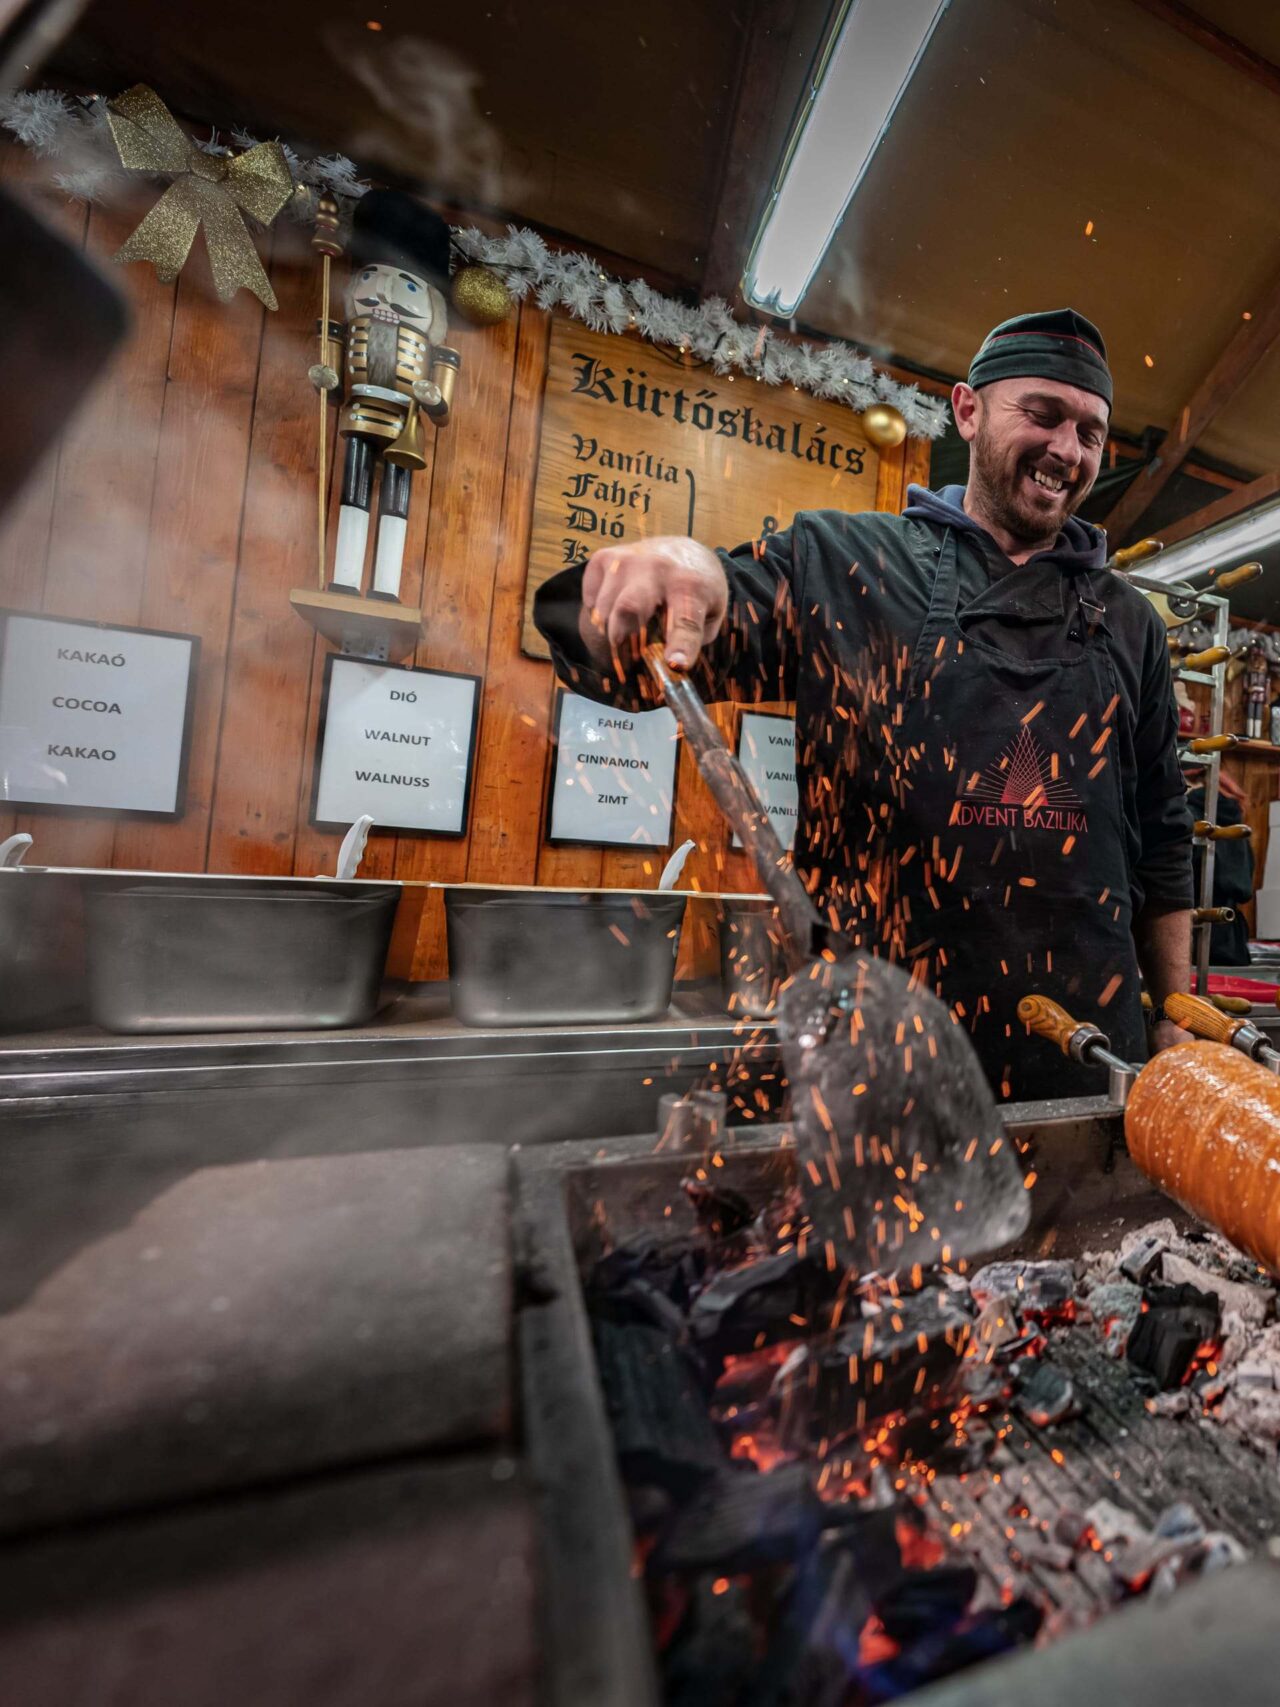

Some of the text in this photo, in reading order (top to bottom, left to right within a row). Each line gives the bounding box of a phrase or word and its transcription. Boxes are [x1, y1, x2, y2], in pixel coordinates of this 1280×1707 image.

[571, 353, 867, 475] Kürtőskalács
[572, 433, 679, 484] Vanília
[562, 472, 652, 514] Fahéj
[564, 502, 625, 538] Dió
[57, 647, 126, 668] KAKAÓ
[389, 690, 418, 703] DIÓ
[52, 696, 122, 715] COCOA
[598, 718, 634, 731] FAHÉJ
[364, 729, 432, 746] WALNUT
[768, 736, 795, 747] VANI
[47, 744, 117, 761] KAKAO
[577, 753, 649, 770] CINNAMON
[354, 770, 431, 788] WALNUSS
[765, 771, 797, 782] VANIL
[597, 794, 629, 805] ZIMT
[763, 806, 799, 817] VANILL
[1023, 809, 1088, 833] BAZILIKA
